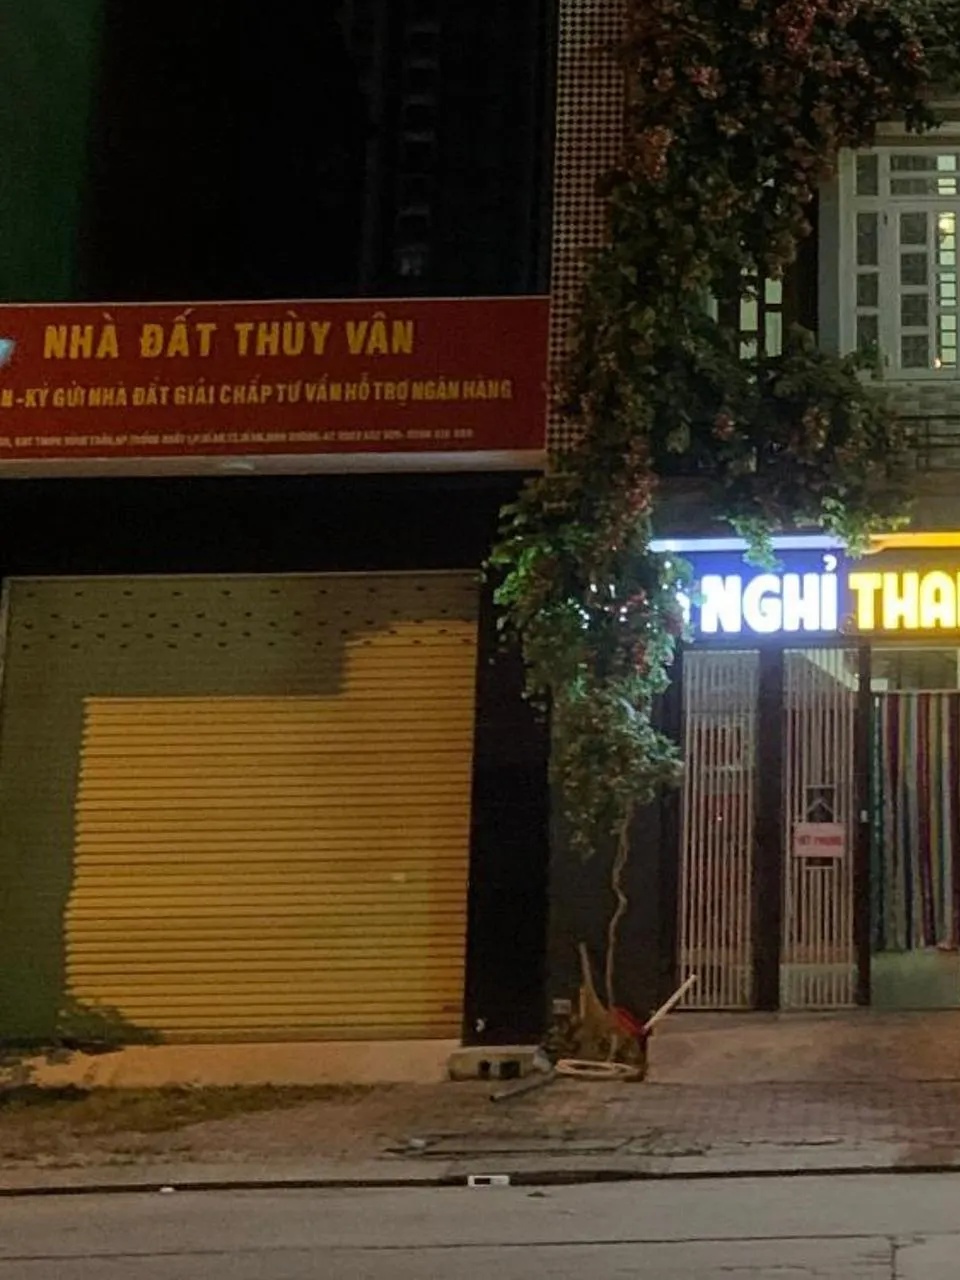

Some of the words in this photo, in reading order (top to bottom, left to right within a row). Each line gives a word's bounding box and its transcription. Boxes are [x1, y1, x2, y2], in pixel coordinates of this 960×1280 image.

[43, 311, 119, 359] NHÀ
[140, 307, 219, 357] ĐẤT
[234, 310, 331, 356] THÙY
[346, 310, 414, 355] VÂN
[88, 380, 127, 406] NHÀ
[699, 554, 839, 633] NGHỈ
